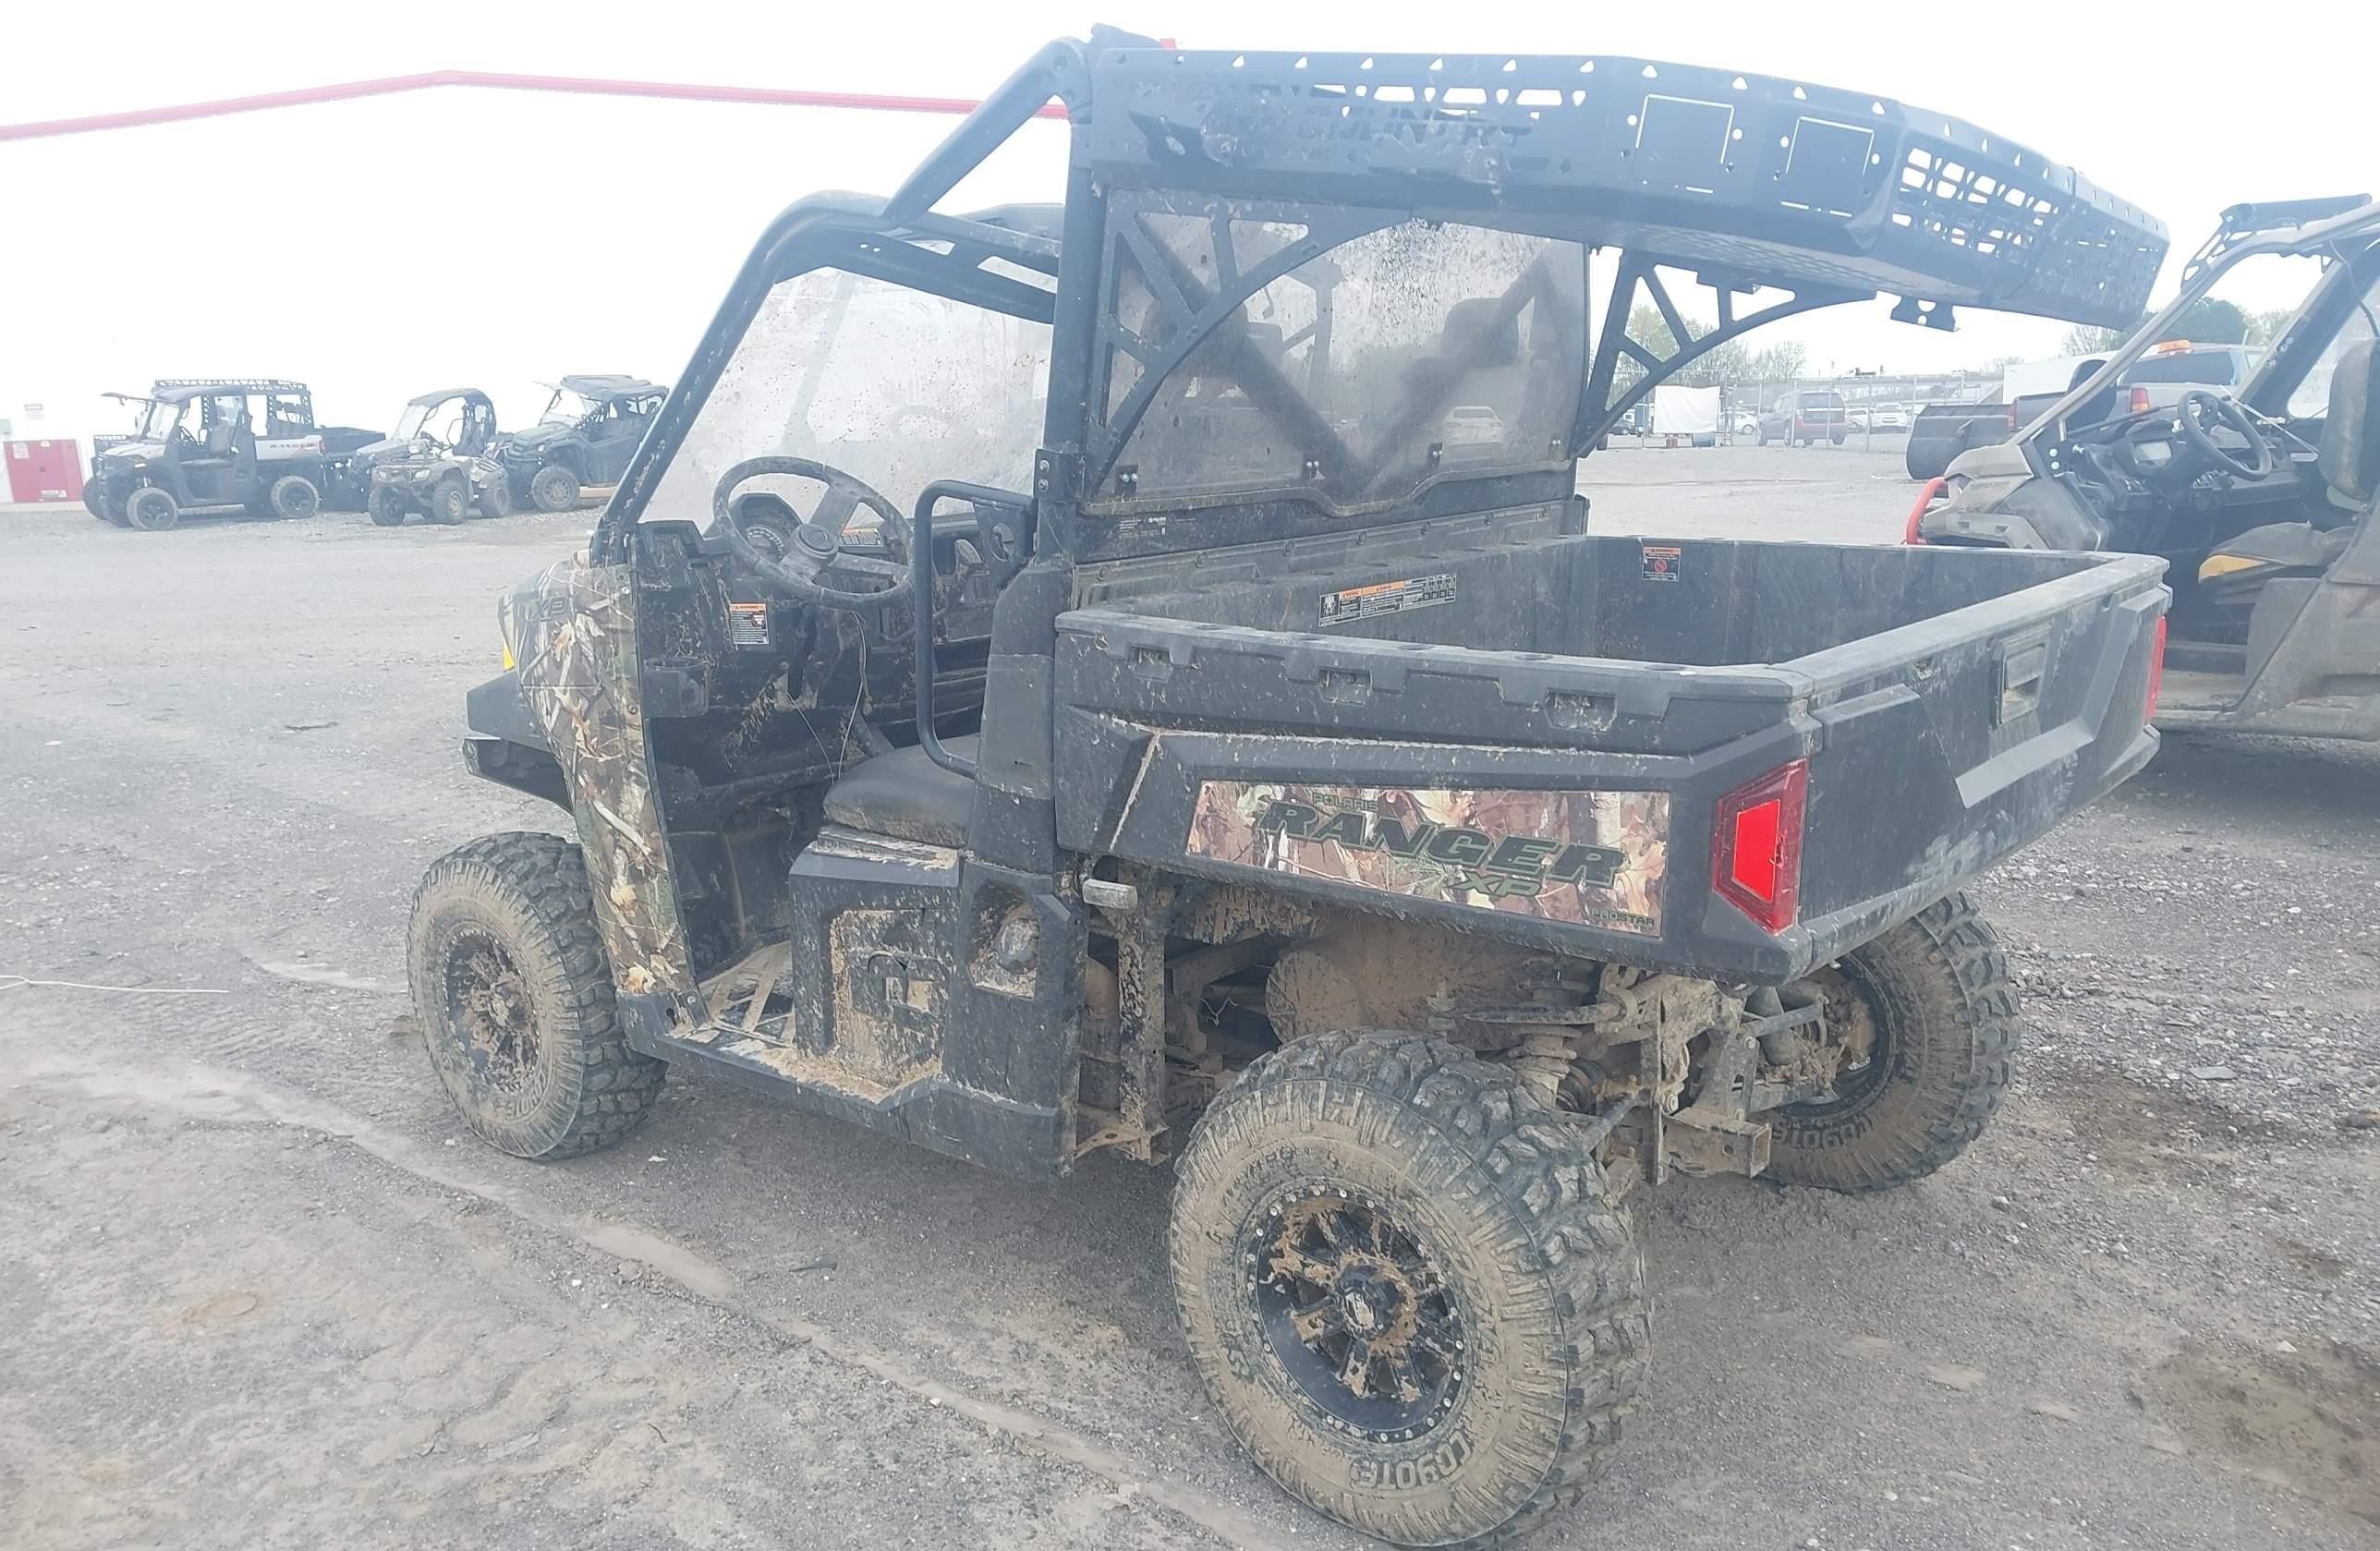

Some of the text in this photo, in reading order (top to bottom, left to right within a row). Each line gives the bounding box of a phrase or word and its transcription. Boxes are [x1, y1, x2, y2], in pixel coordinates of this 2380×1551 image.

[1313, 793, 1379, 812] POLARIS
[1256, 800, 1627, 889] RANGER
[1446, 870, 1543, 898] XP
[1590, 908, 1656, 927] PROSTAR
[1351, 1431, 1471, 1489] COYOTE
